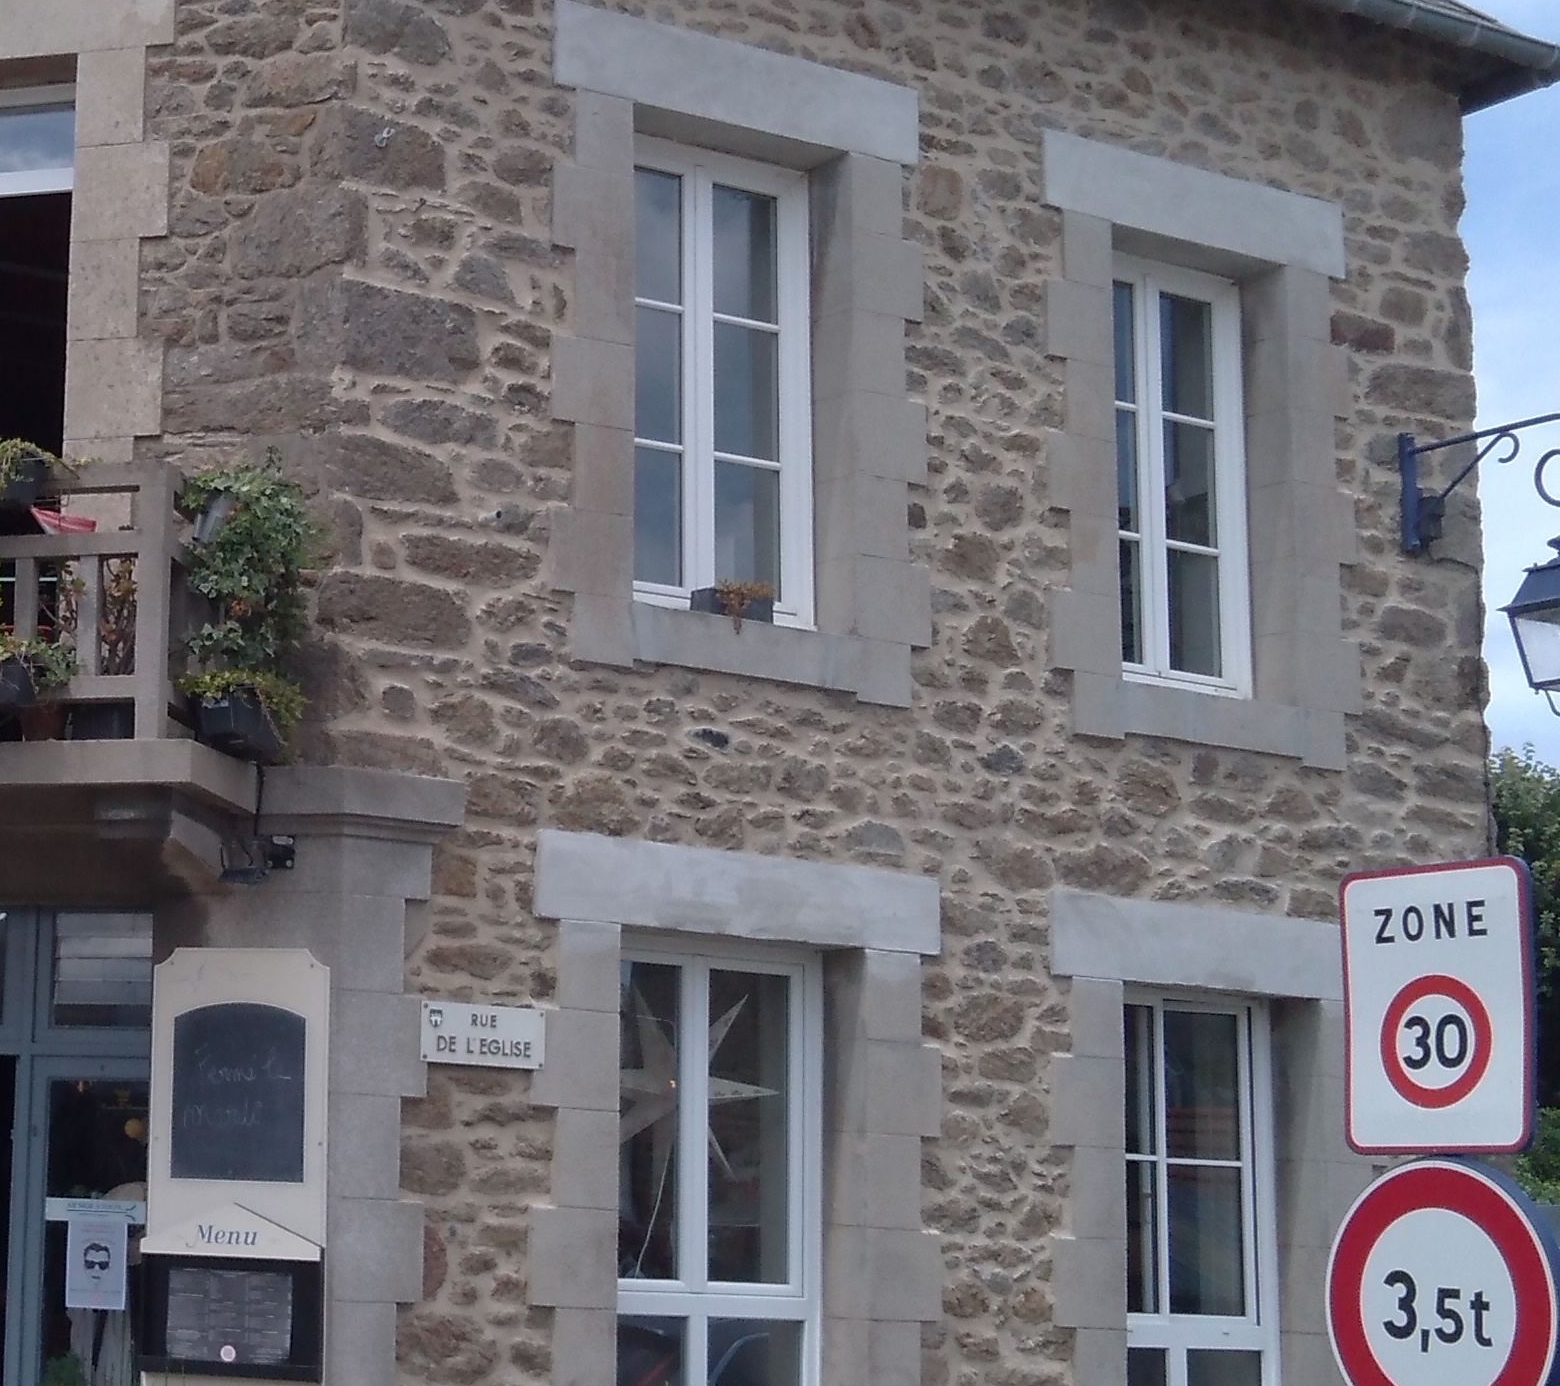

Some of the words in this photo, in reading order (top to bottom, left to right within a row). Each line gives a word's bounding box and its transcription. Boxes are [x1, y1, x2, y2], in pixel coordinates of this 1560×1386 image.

[1373, 899, 1490, 945] ZONE
[471, 1013, 497, 1028] RUE
[436, 1035, 457, 1053] DE
[466, 1037, 532, 1058] L'EGLISE
[1402, 1012, 1470, 1070] 30
[186, 1224, 258, 1248] Menu
[1381, 1269, 1493, 1354] 3,5t
